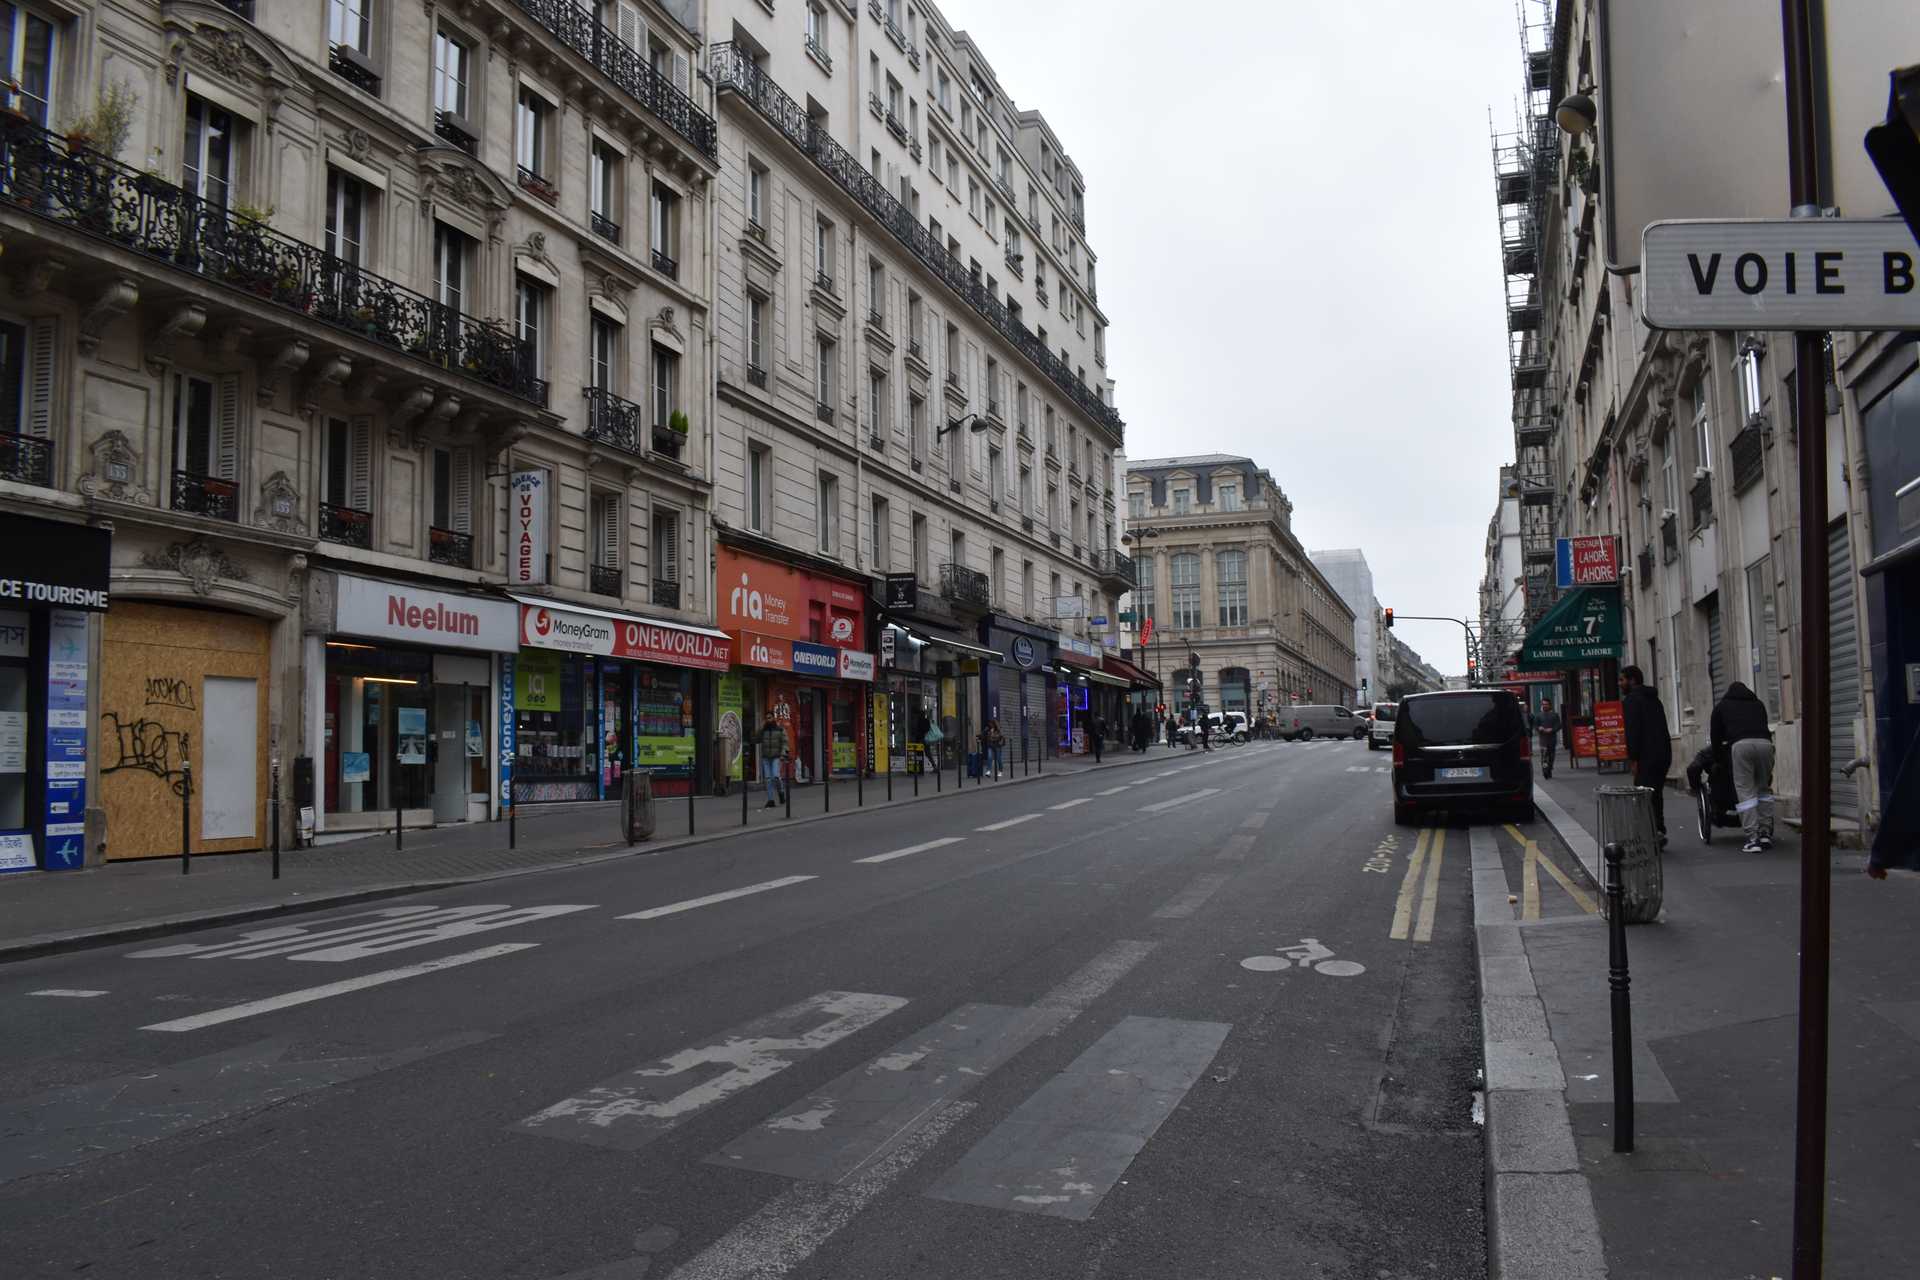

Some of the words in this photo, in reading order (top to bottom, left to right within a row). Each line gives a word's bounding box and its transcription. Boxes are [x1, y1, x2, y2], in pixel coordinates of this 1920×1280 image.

[1687, 252, 1845, 295] VOIE
[1882, 252, 1915, 295] B
[512, 474, 541, 489] AGENCE
[521, 484, 531, 492] DE
[520, 495, 532, 582] VOYAGES
[1579, 550, 1610, 564] LAHORE
[1577, 566, 1616, 582] LAHORE
[24, 582, 109, 608] TOURISME
[731, 571, 763, 621] ria
[765, 593, 786, 609] Money
[388, 594, 479, 636] Neelum
[765, 609, 792, 625] Transfer
[553, 618, 609, 642] MoneyGram
[625, 623, 713, 657] ONEWORLD
[713, 648, 729, 661] NET
[750, 637, 769, 663] ria
[1543, 636, 1601, 647] RESTAURANT
[793, 651, 836, 669] ONEWORLD
[1533, 649, 1565, 658] LAHORE
[1581, 647, 1613, 657] LAHORE
